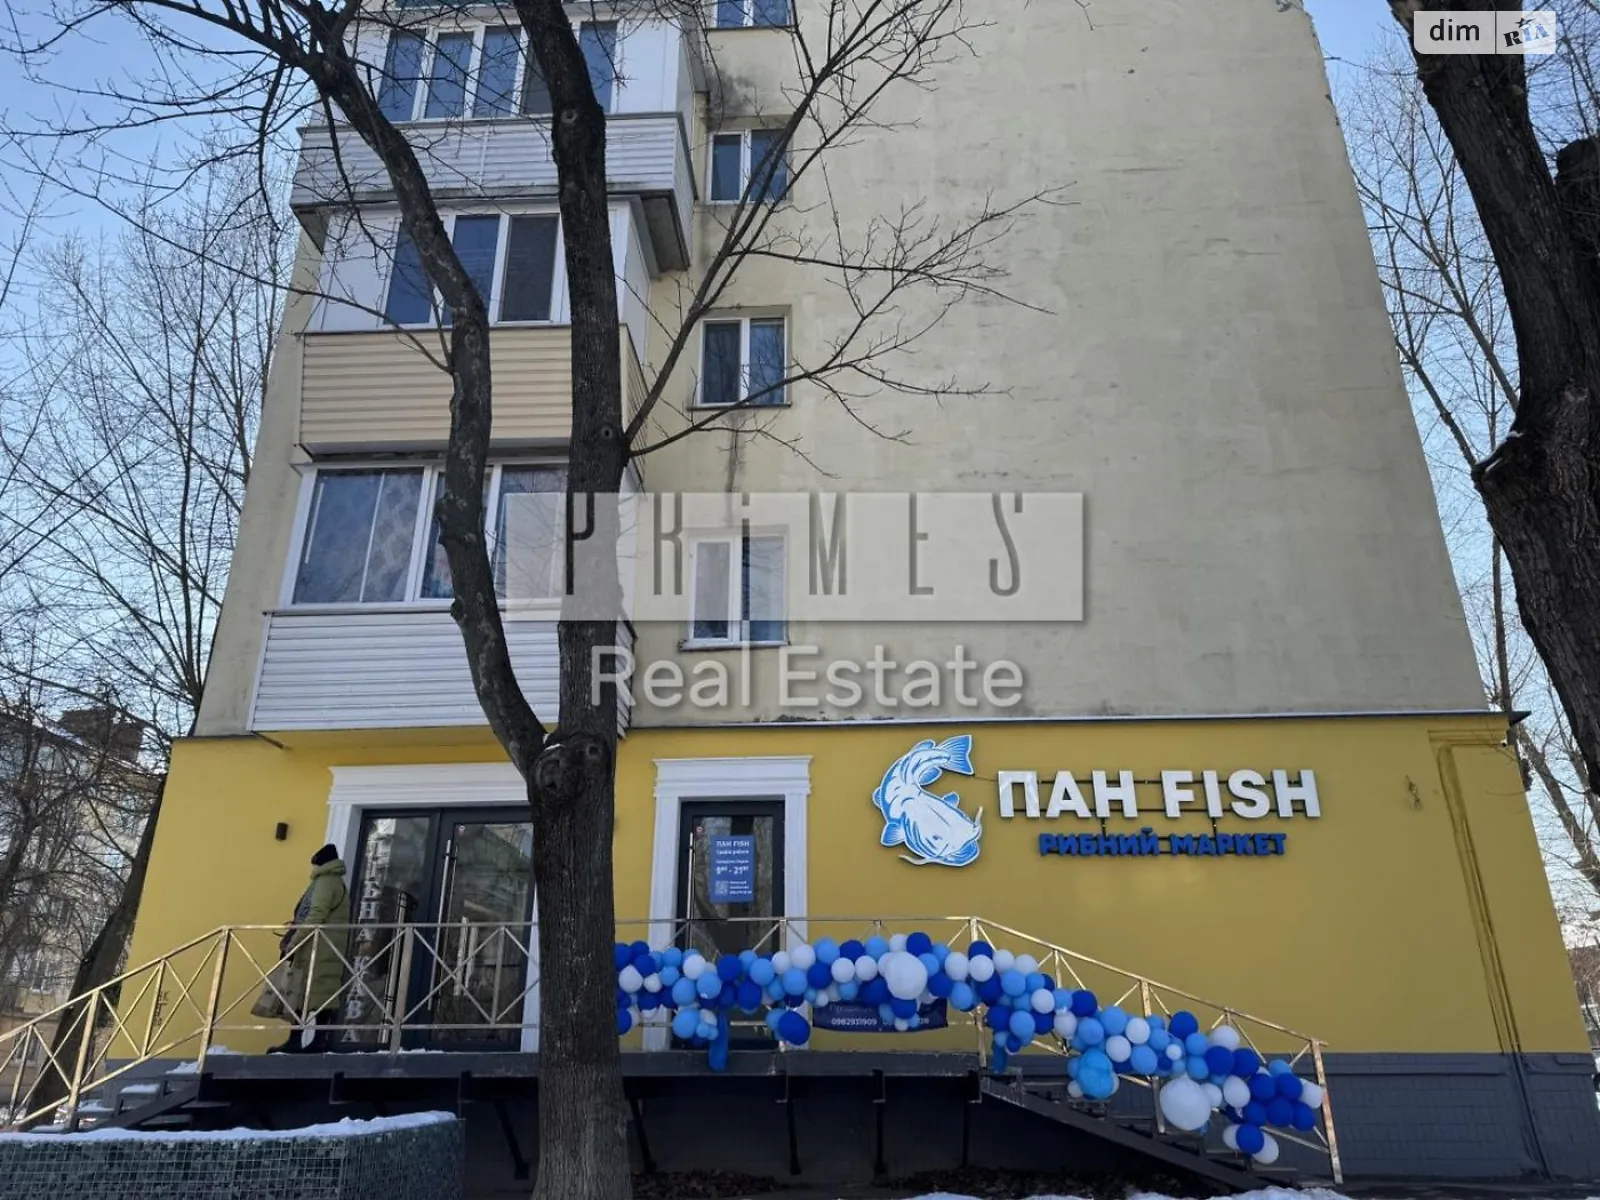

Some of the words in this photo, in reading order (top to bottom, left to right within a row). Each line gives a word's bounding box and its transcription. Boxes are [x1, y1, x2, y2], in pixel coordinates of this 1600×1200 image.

[997, 770, 1138, 818] ПАН
[1160, 769, 1321, 819] FISH
[1039, 827, 1160, 857] РИБНИЙ
[1168, 833, 1287, 856] МАРКЕТ
